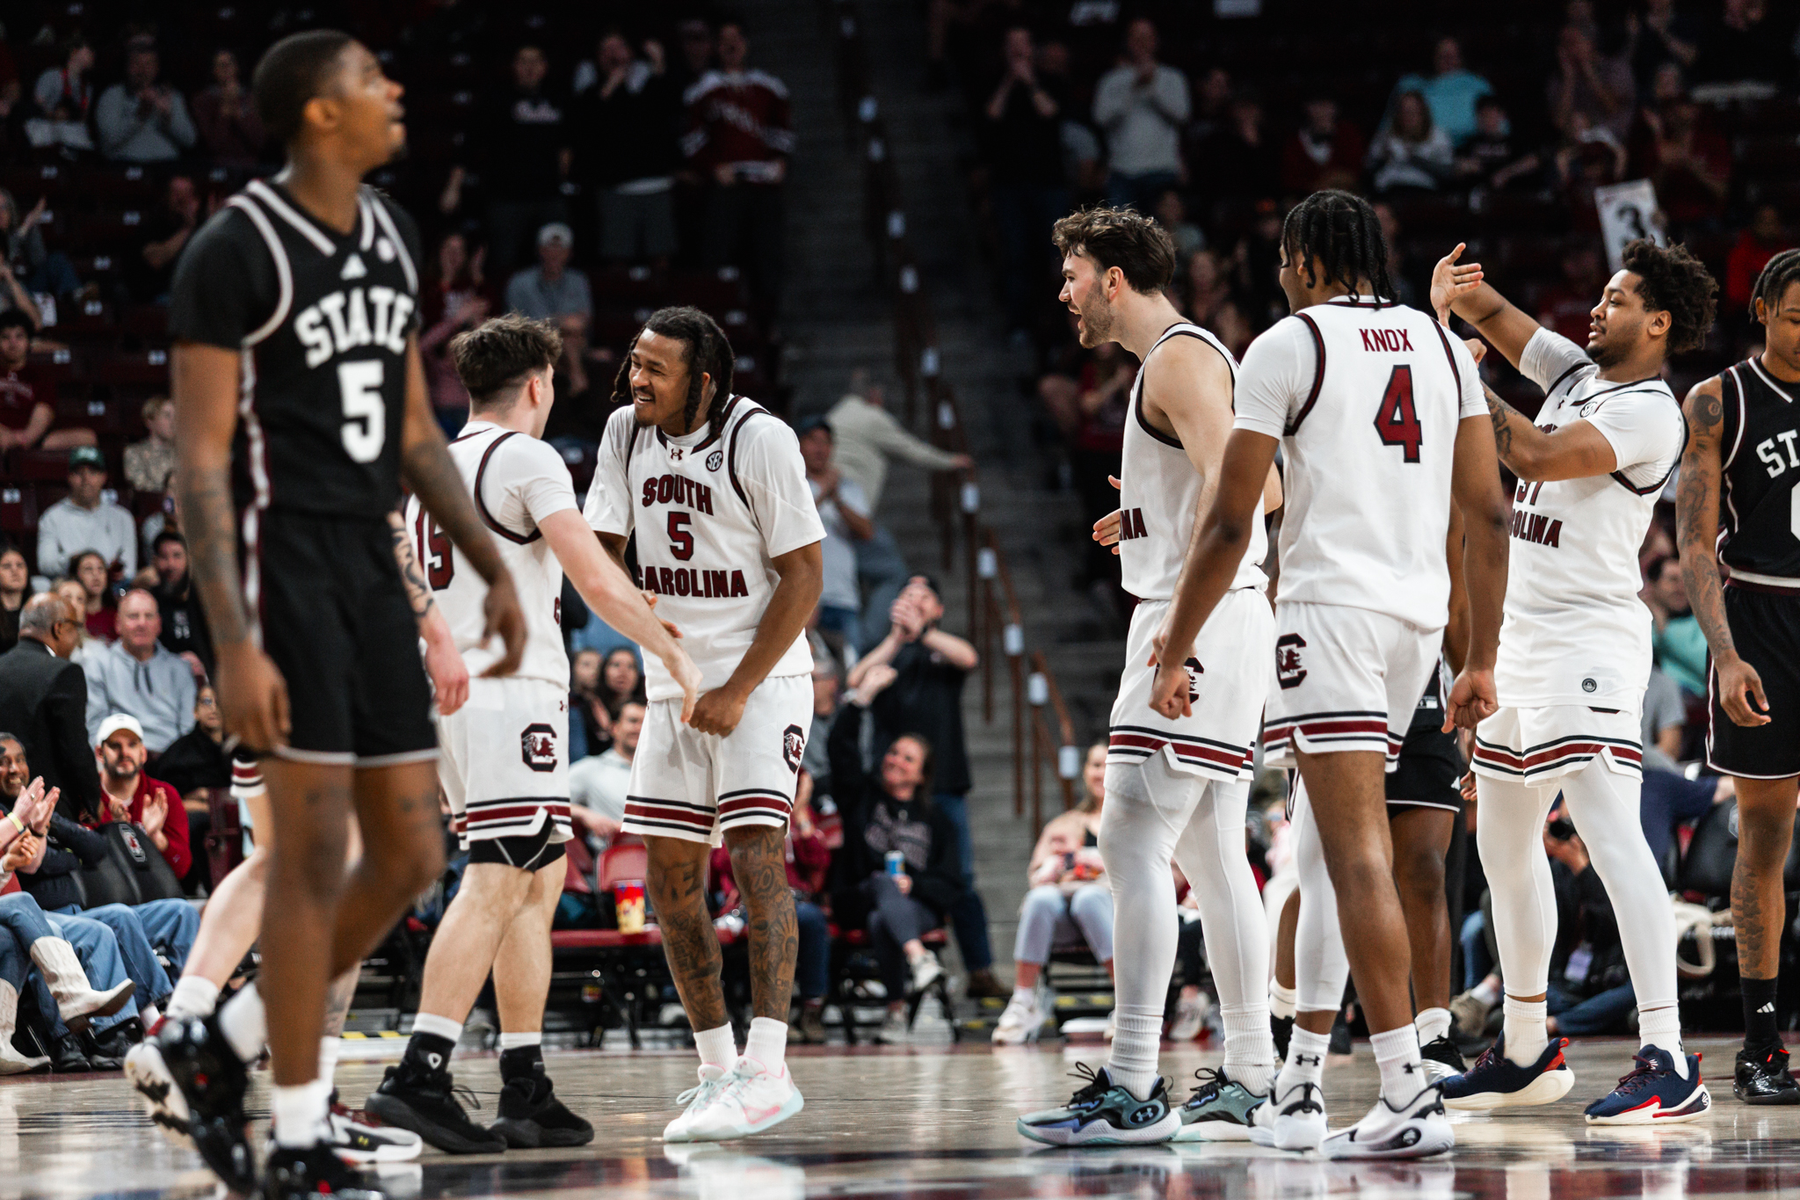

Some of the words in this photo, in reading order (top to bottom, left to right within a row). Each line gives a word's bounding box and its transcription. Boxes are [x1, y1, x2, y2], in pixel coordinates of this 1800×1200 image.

[293, 284, 415, 370] STATE
[1358, 328, 1414, 352] KNOX
[336, 357, 386, 464] 5
[1373, 364, 1423, 463] 4
[642, 473, 714, 517] SOUTH
[667, 511, 694, 561] 5
